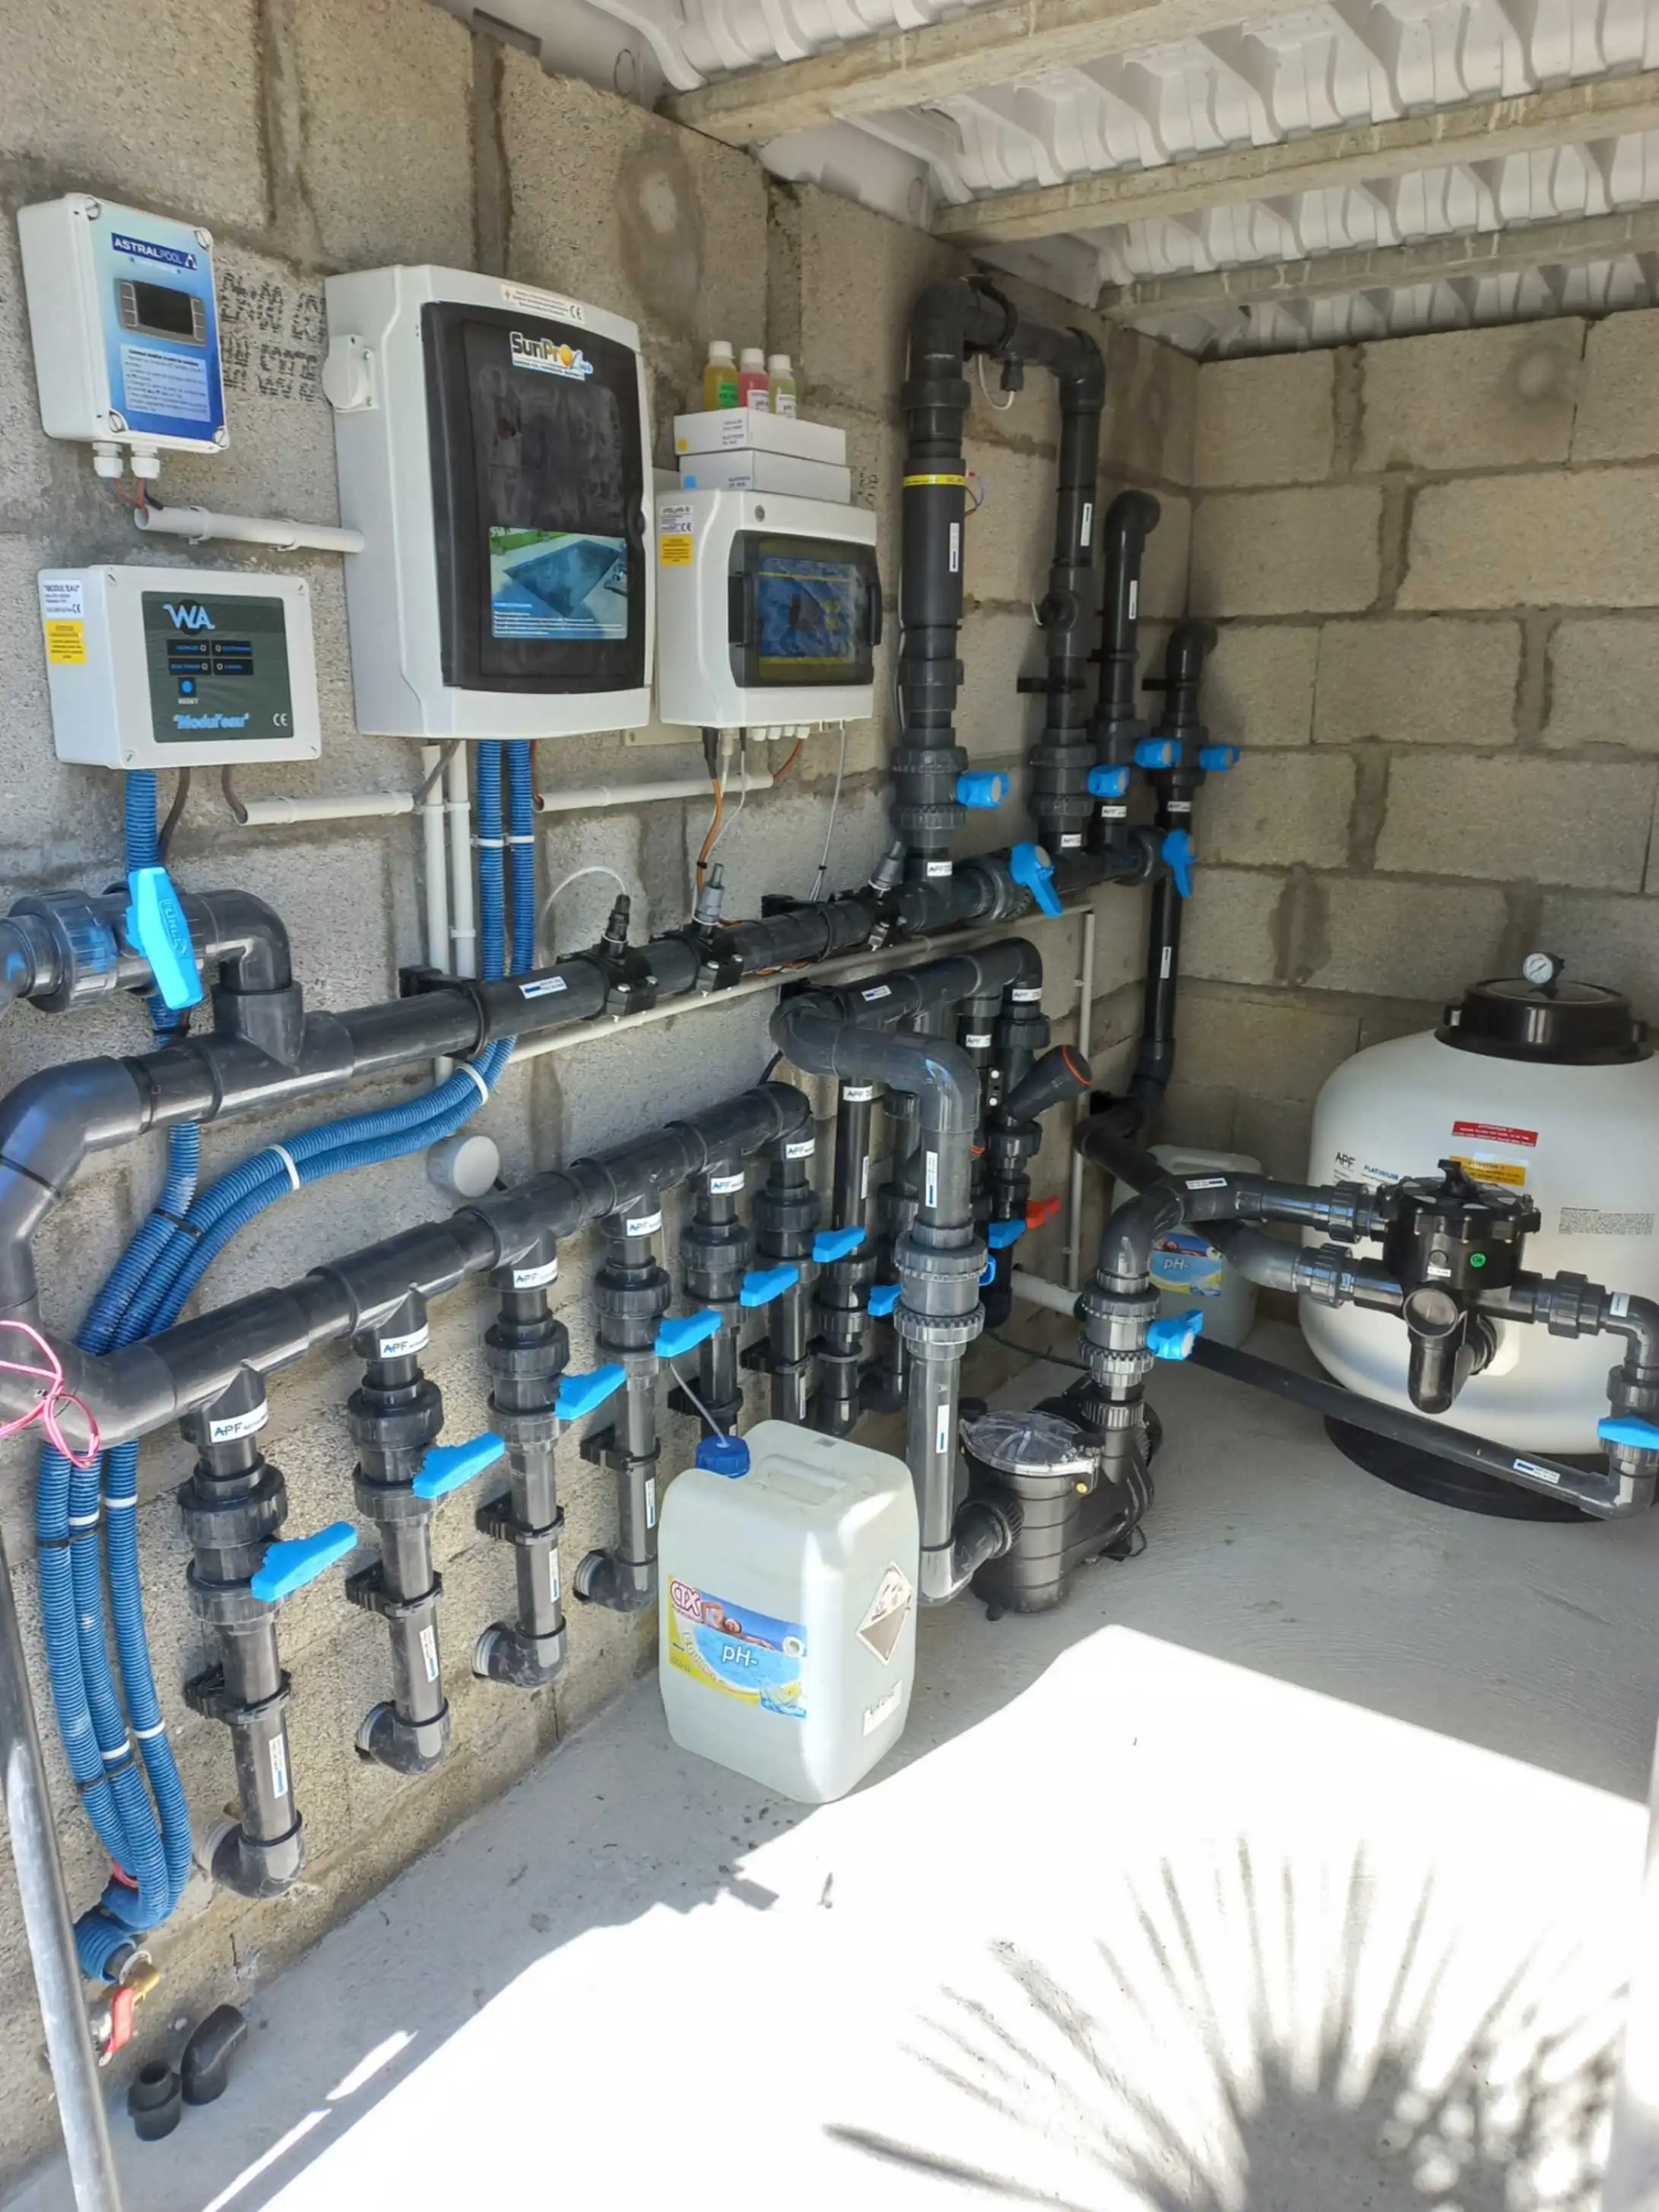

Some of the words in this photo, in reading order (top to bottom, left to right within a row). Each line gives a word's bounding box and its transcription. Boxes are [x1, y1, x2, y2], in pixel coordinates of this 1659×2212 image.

[163, 603, 216, 630] WA
[1335, 1152, 1356, 1168] APF
[1364, 1165, 1399, 1181] PLATINIUM
[383, 1341, 408, 1353] APF
[214, 1422, 243, 1437] APF
[722, 1644, 758, 1667] pH-
